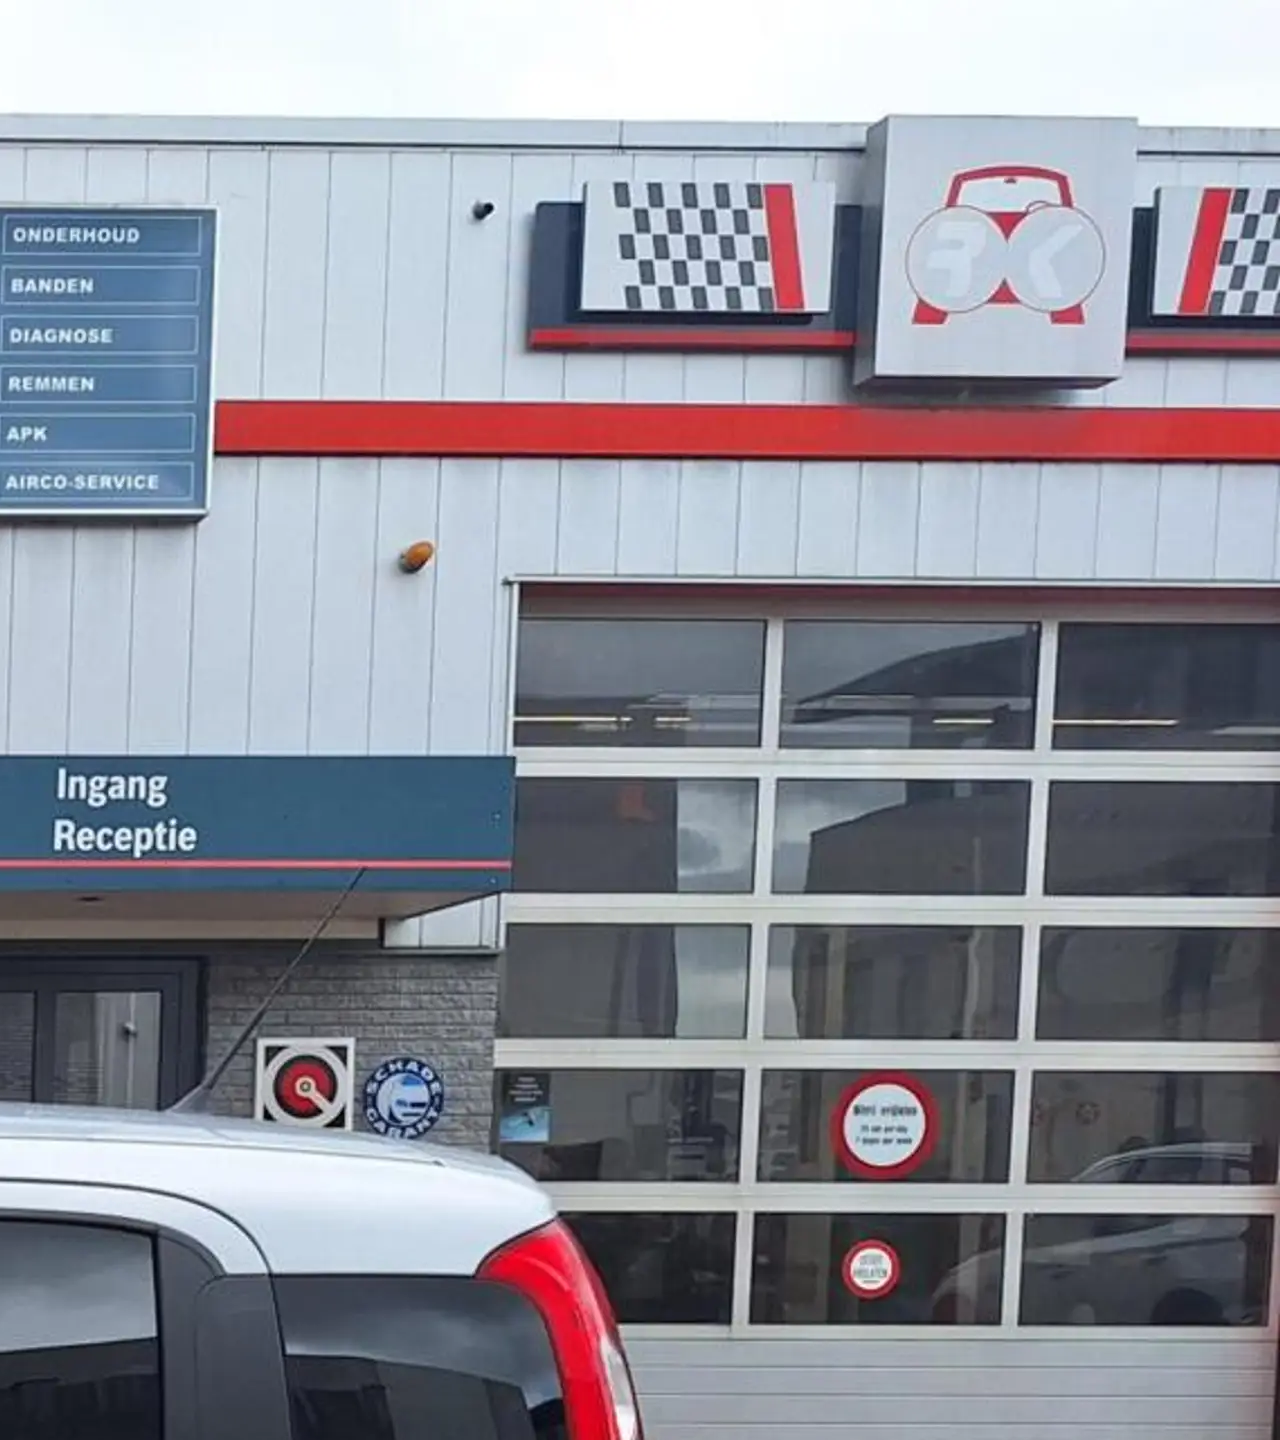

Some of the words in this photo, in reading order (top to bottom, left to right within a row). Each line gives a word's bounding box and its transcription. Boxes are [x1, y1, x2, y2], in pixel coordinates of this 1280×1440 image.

[12, 226, 141, 244] ONDERHOUD
[10, 277, 95, 294] BANDEN
[9, 327, 115, 345] DIAGNOSE
[7, 375, 95, 392] REMMEN
[6, 425, 48, 442] APK
[5, 473, 160, 490] AIRCO-SERVICE
[57, 767, 169, 808] Ingang
[53, 817, 198, 859] Receptie
[365, 1060, 442, 1096] SCHADE
